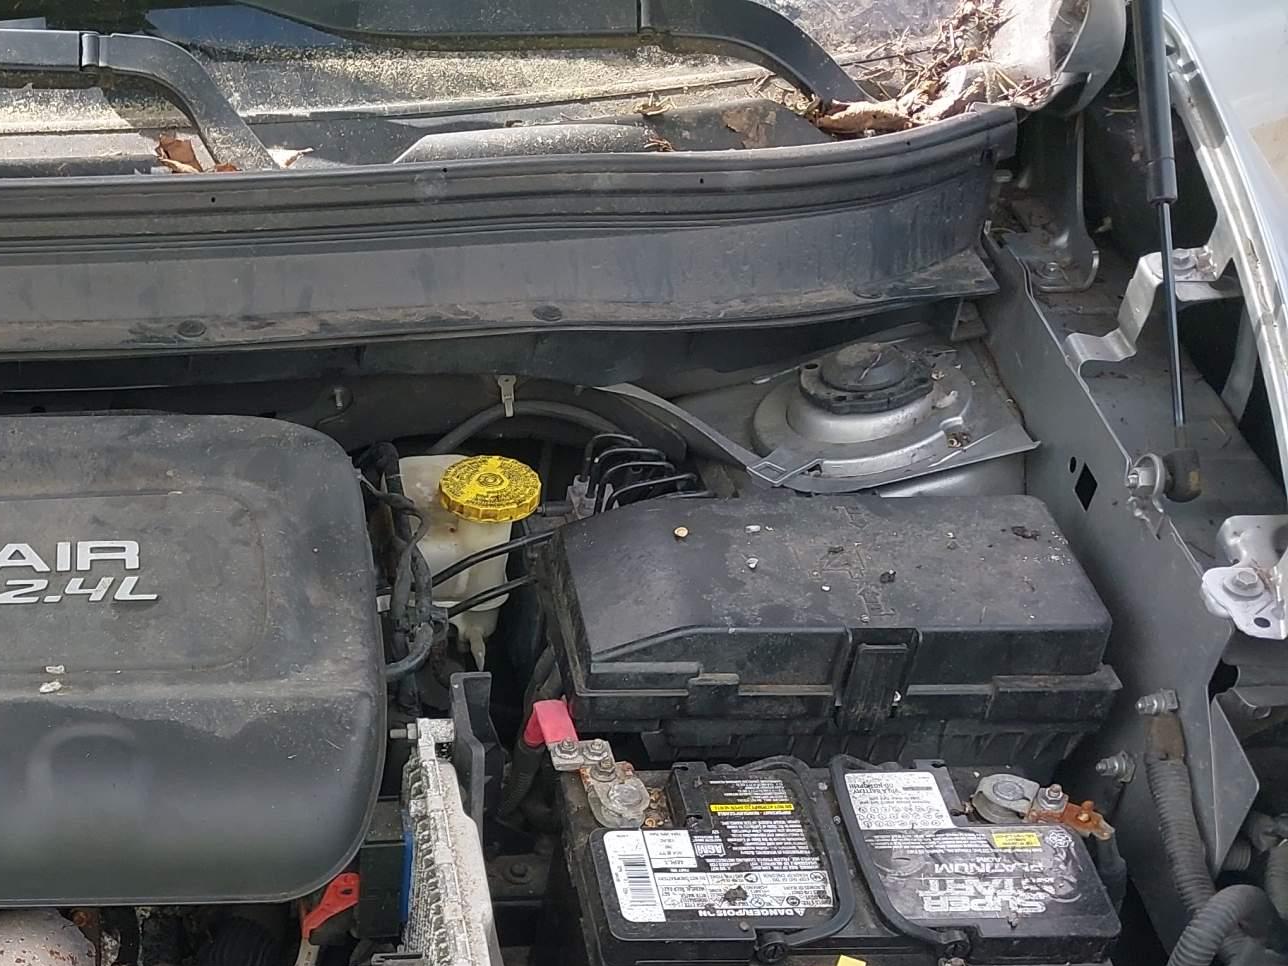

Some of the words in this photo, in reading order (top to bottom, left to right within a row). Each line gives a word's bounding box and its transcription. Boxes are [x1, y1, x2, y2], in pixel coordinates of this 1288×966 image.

[696, 844, 723, 854] AGM
[934, 862, 1044, 874] PLATINUM
[923, 895, 1047, 913] SUPER
